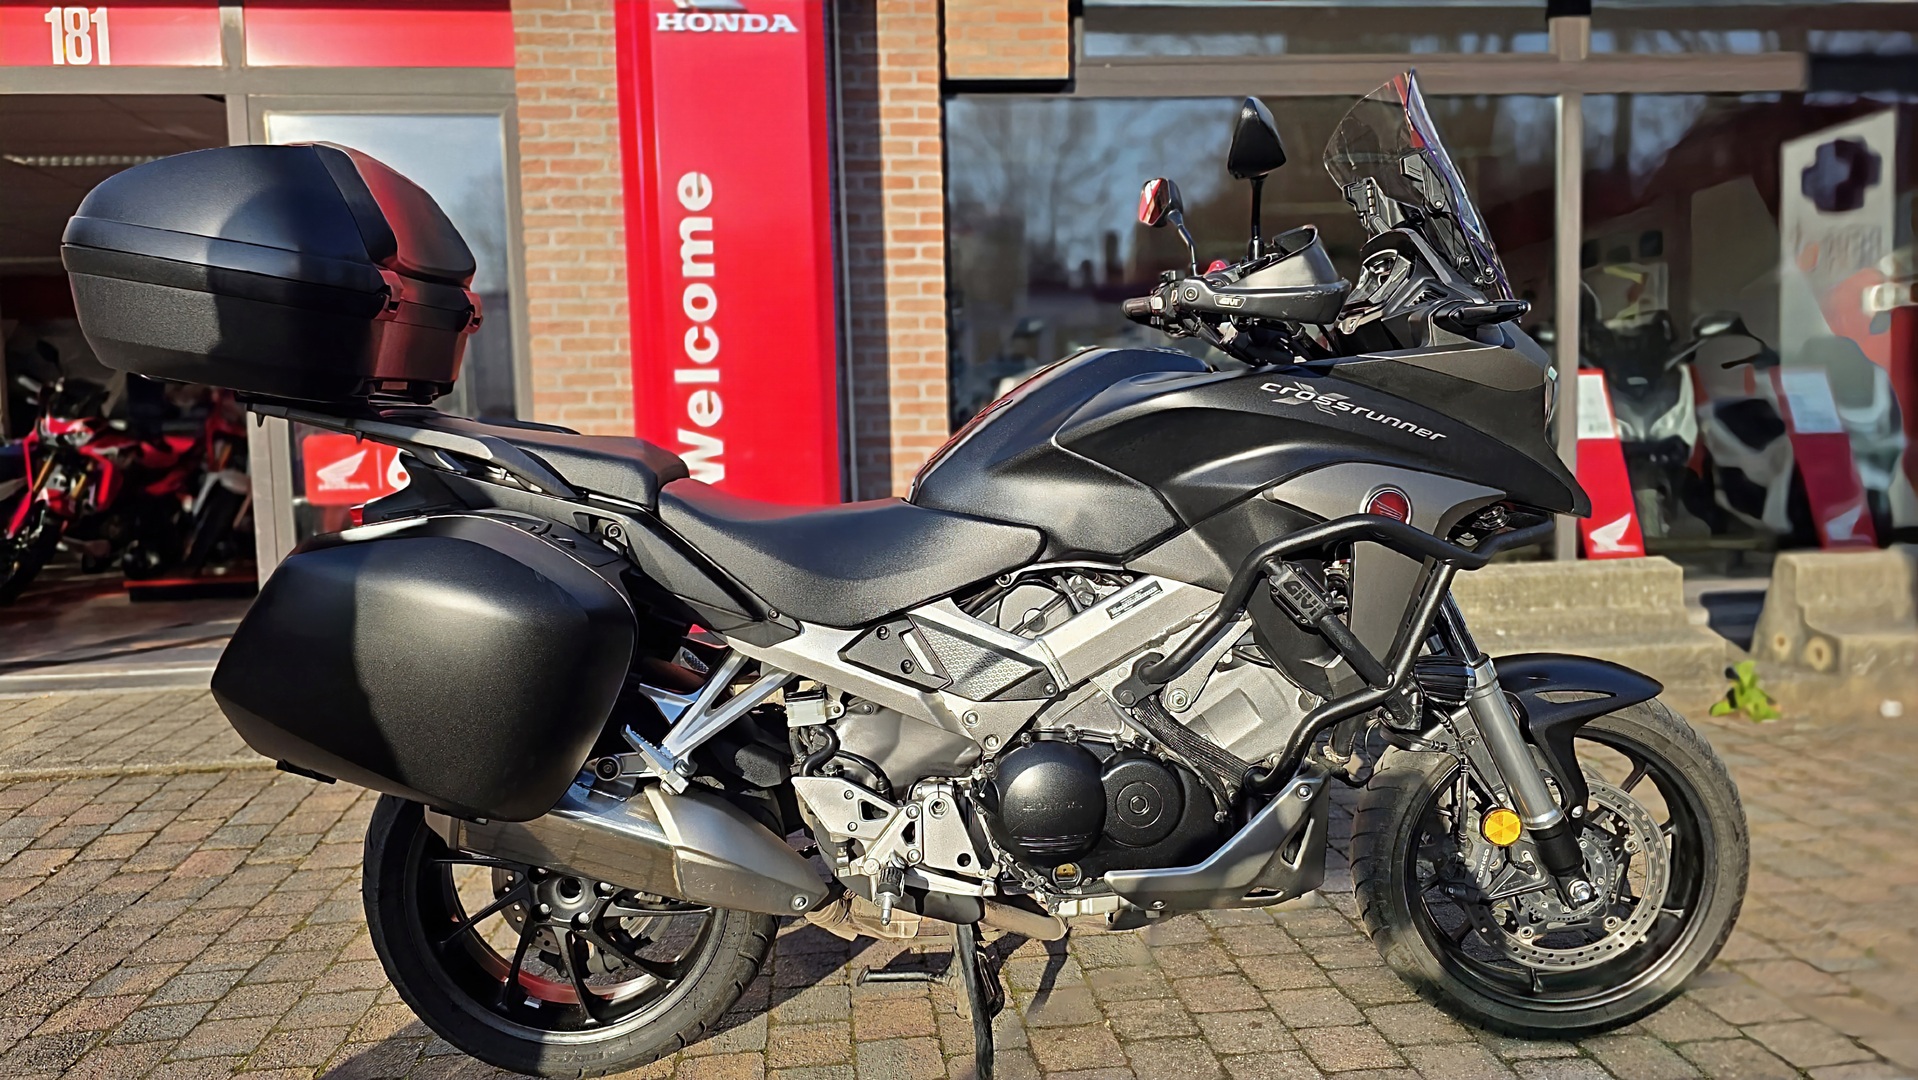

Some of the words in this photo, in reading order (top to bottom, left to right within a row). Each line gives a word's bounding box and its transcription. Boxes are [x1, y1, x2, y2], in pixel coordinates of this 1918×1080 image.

[44, 7, 111, 66] 181
[656, 12, 799, 33] HONDA
[674, 171, 726, 485] Welcome
[1259, 381, 1447, 441] crossrunner
[1475, 848, 1490, 884] TOKICO
